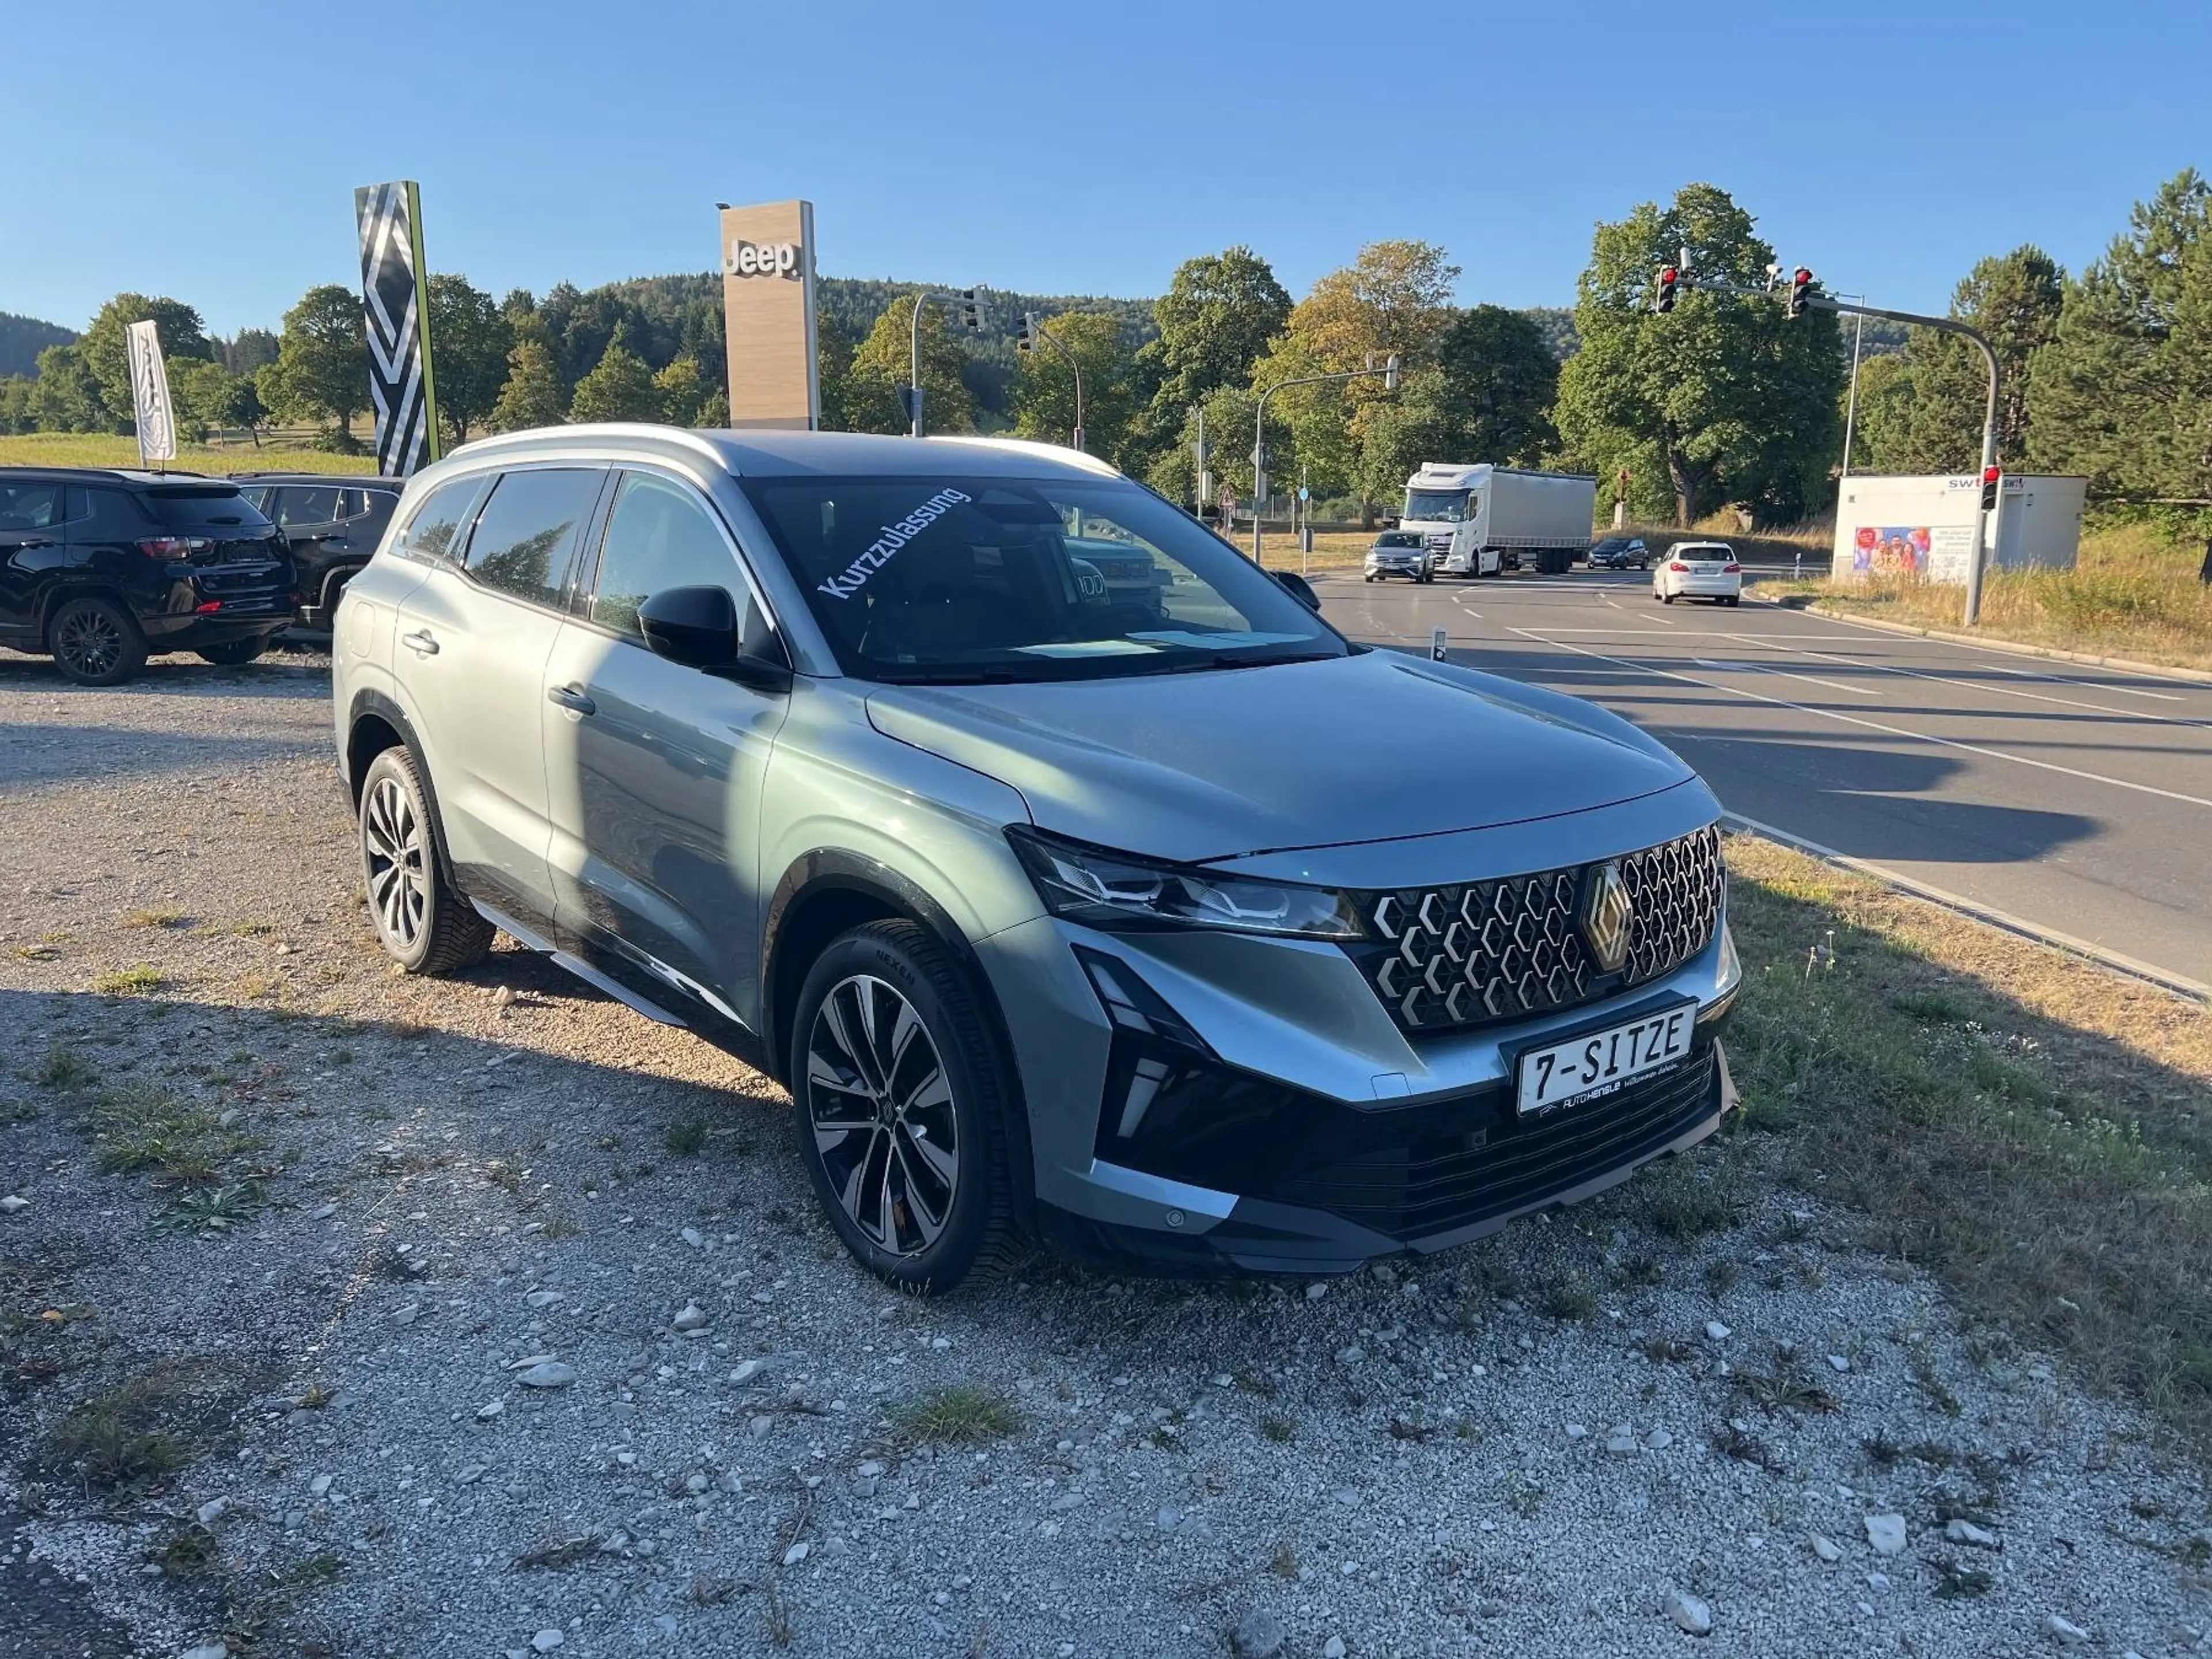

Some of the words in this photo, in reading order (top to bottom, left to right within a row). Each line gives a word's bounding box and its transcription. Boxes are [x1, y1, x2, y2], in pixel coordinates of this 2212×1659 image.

[817, 487, 972, 600] Kurzzulassung
[876, 949, 915, 986] NEXEN
[1536, 1012, 1684, 1100] 7-SITZE
